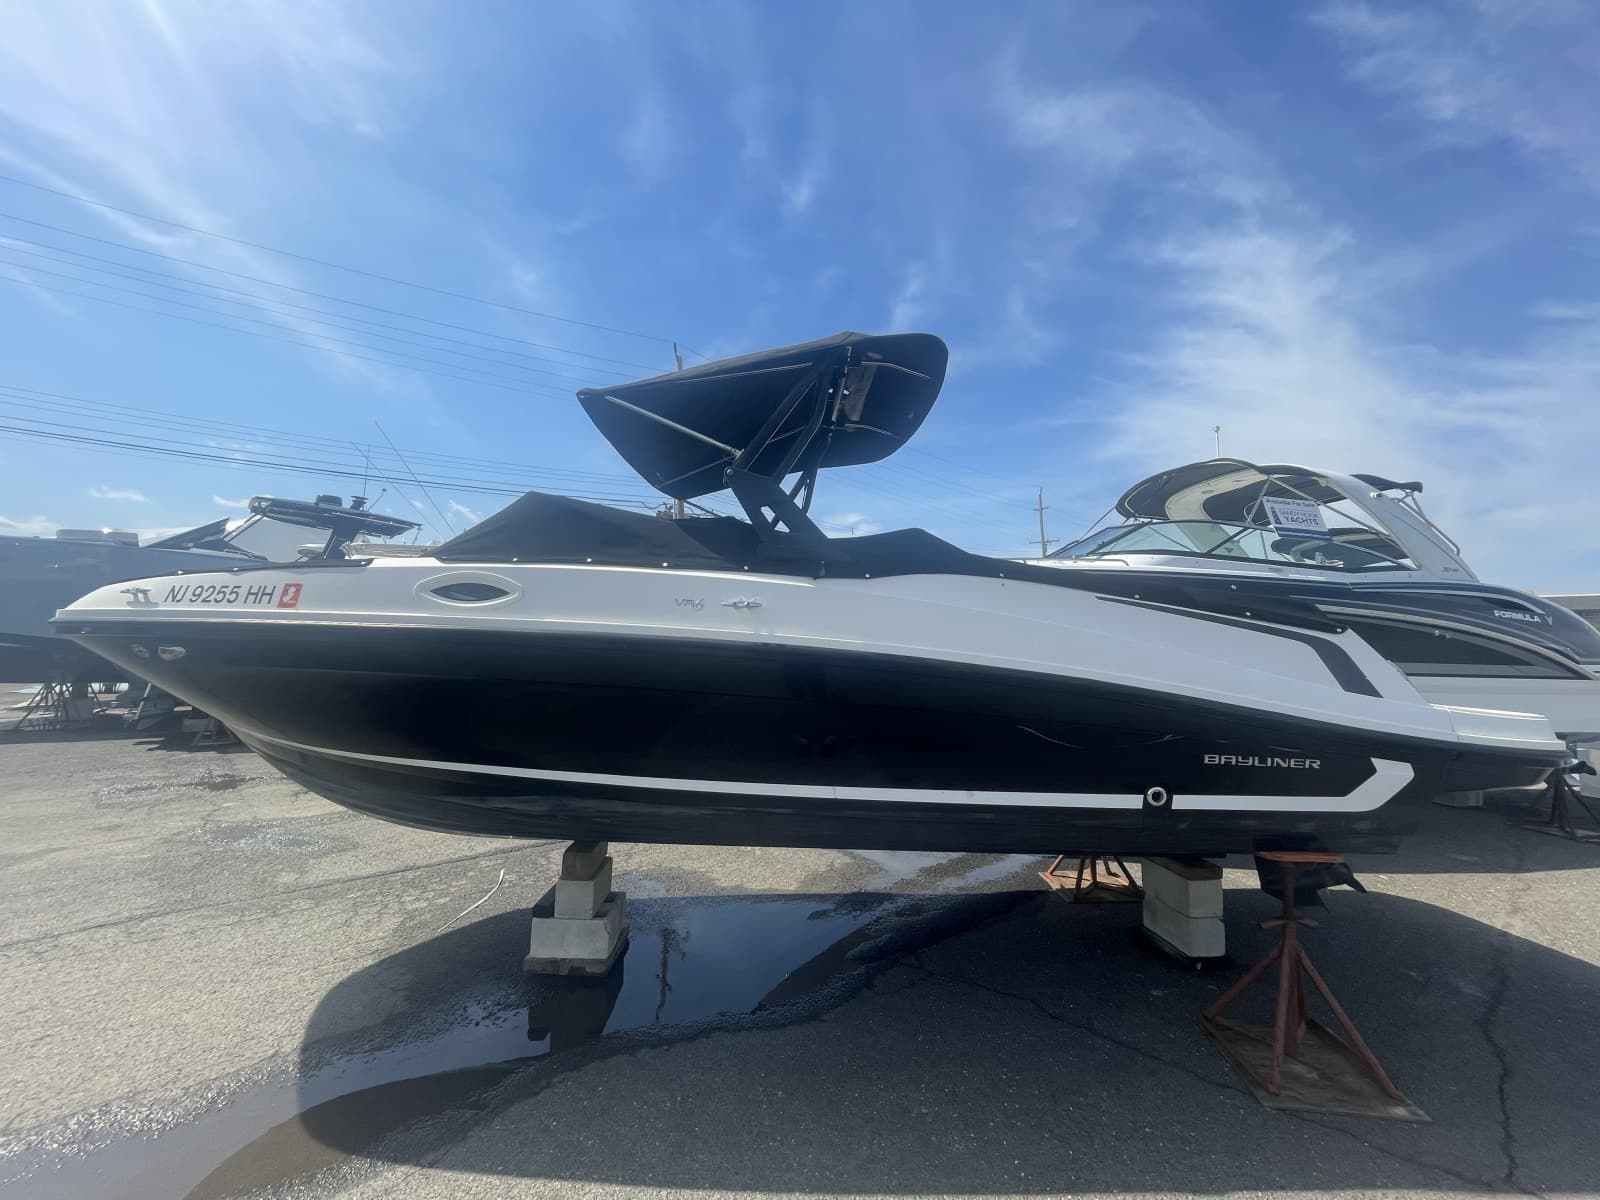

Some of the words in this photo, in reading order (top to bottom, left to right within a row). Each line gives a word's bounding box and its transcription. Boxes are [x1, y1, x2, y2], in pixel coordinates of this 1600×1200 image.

[1283, 515, 1320, 526] YACHTS
[164, 585, 189, 603] NJ
[189, 585, 242, 604] 9255
[243, 586, 277, 605] HH
[1494, 609, 1542, 623] FORMULA
[1203, 754, 1321, 769] BAYLINER
